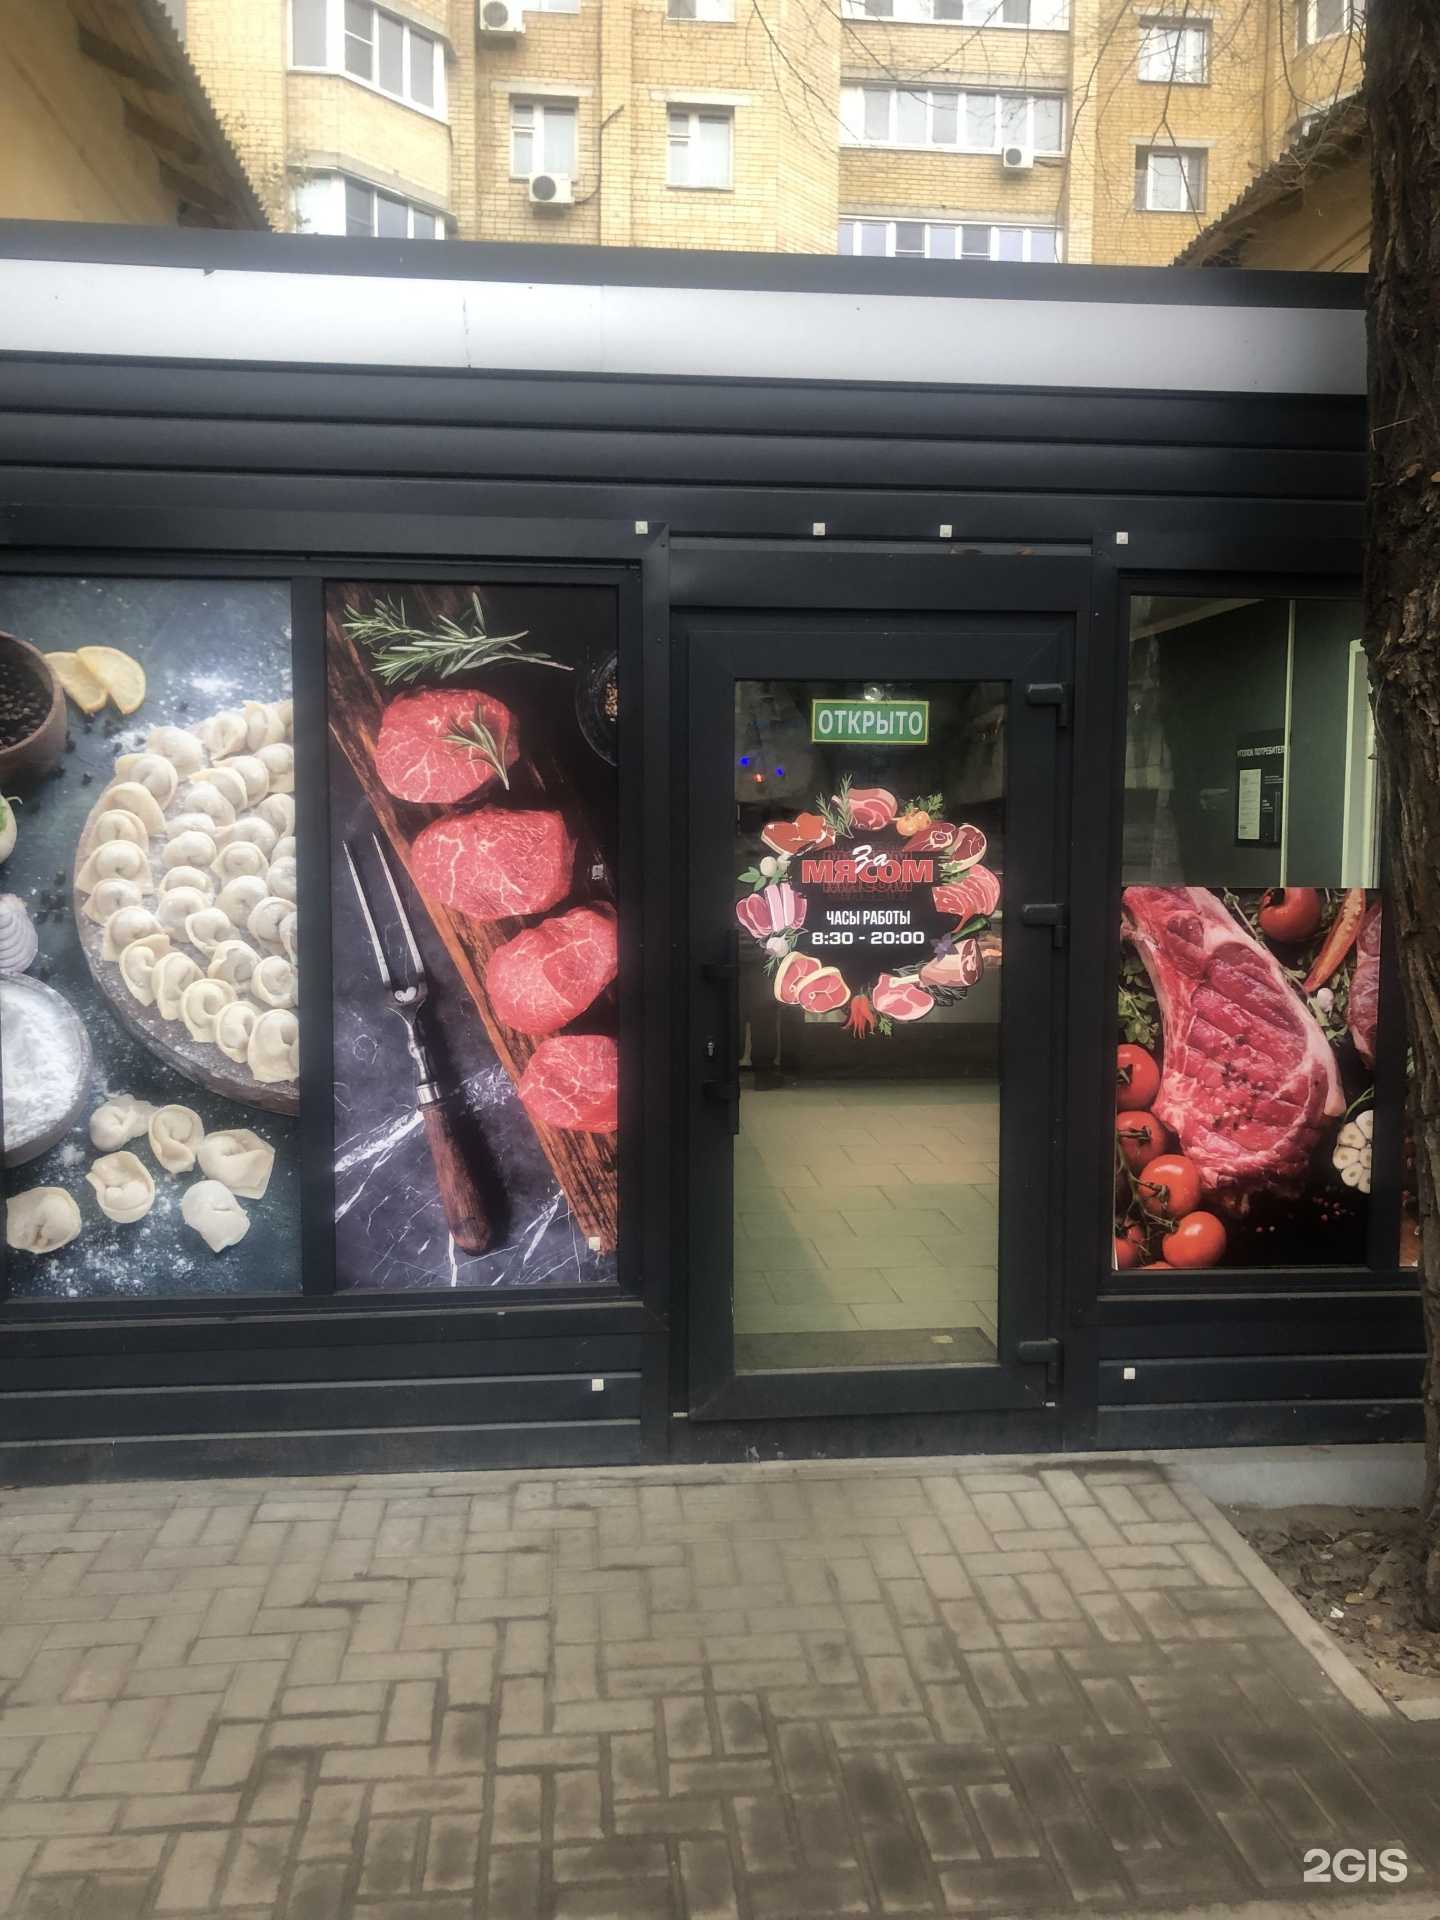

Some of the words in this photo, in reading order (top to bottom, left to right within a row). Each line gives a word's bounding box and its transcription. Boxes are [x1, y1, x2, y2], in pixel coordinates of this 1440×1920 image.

[818, 709, 923, 735] ОТКРЫТО
[801, 859, 934, 883] МЯСОМ
[852, 844, 888, 874] За
[826, 910, 860, 925] ЧАСЫ
[863, 910, 911, 925] РАБОТЫ
[811, 931, 854, 945] 8:30
[870, 931, 925, 945] 20:00
